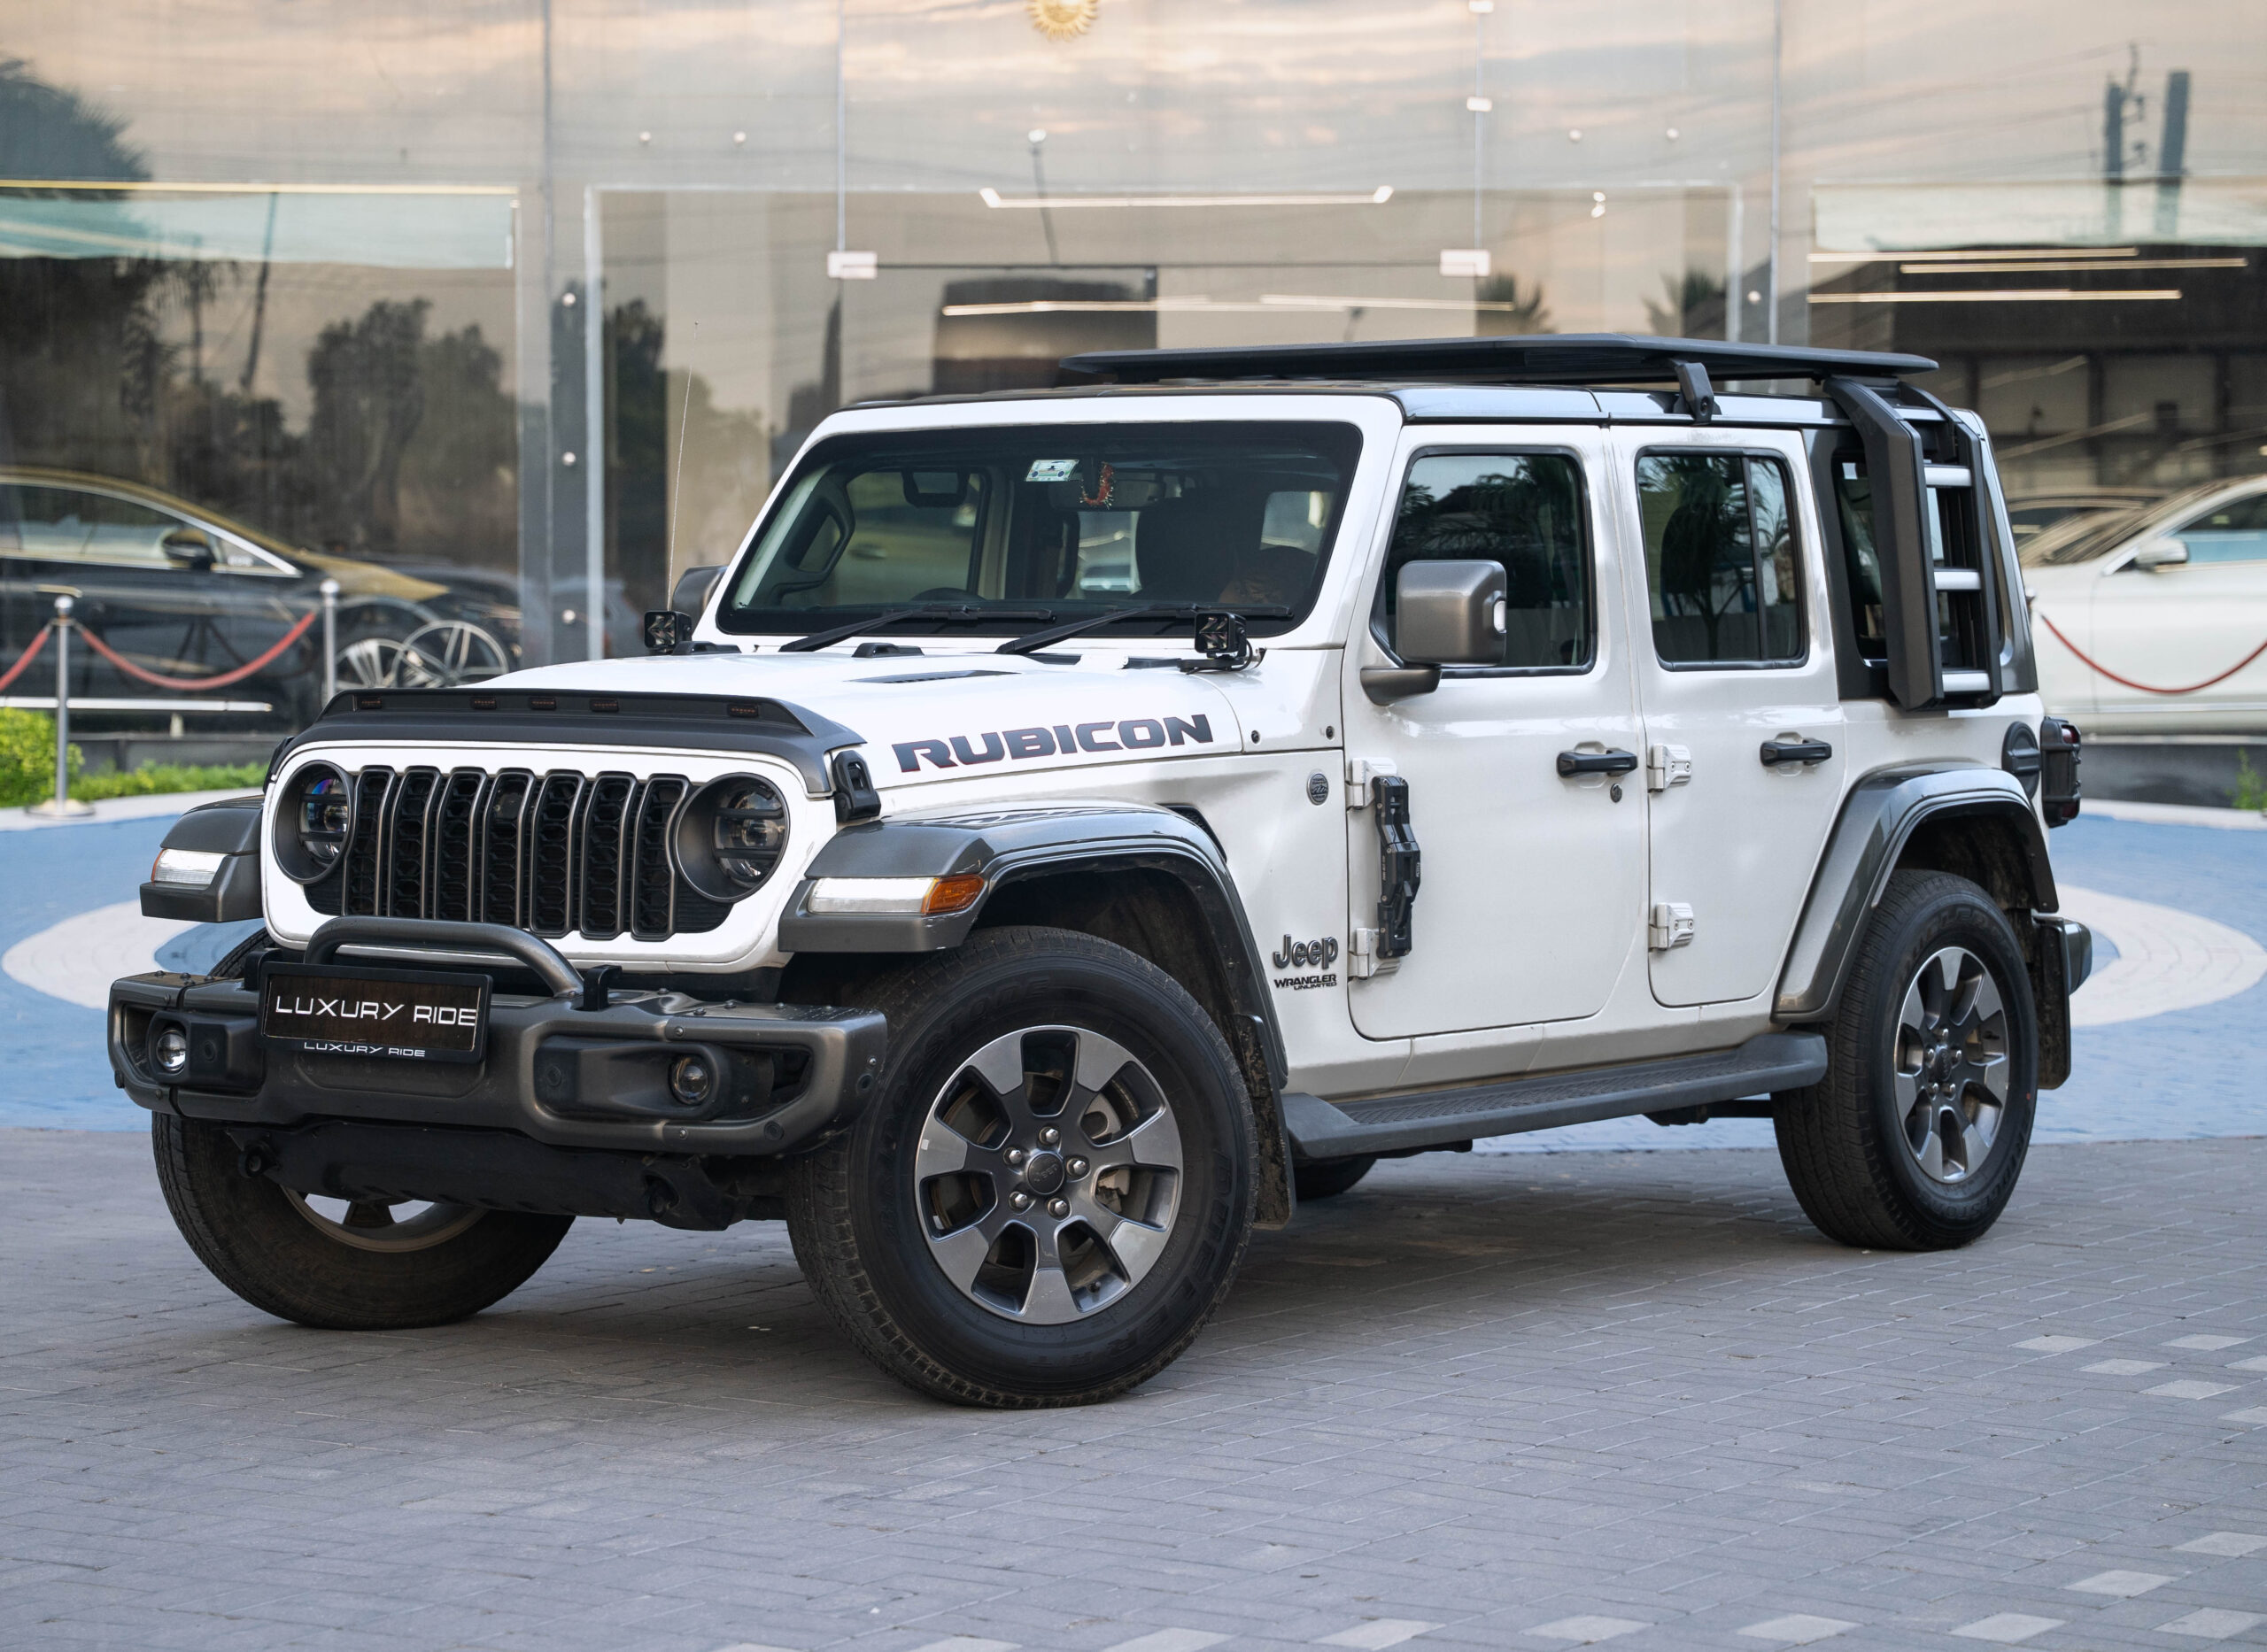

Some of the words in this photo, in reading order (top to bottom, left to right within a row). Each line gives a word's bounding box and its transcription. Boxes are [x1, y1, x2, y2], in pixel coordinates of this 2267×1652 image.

[891, 714, 1214, 773] RUBICON
[1273, 933, 1339, 969] Jeep
[1273, 974, 1337, 988] WRANGLER
[1294, 982, 1337, 991] UNLIMITED
[275, 996, 405, 1020] LUXURY
[413, 1005, 478, 1026] RIDE
[304, 1042, 383, 1054] LUXURY
[388, 1047, 425, 1057] RIDE
